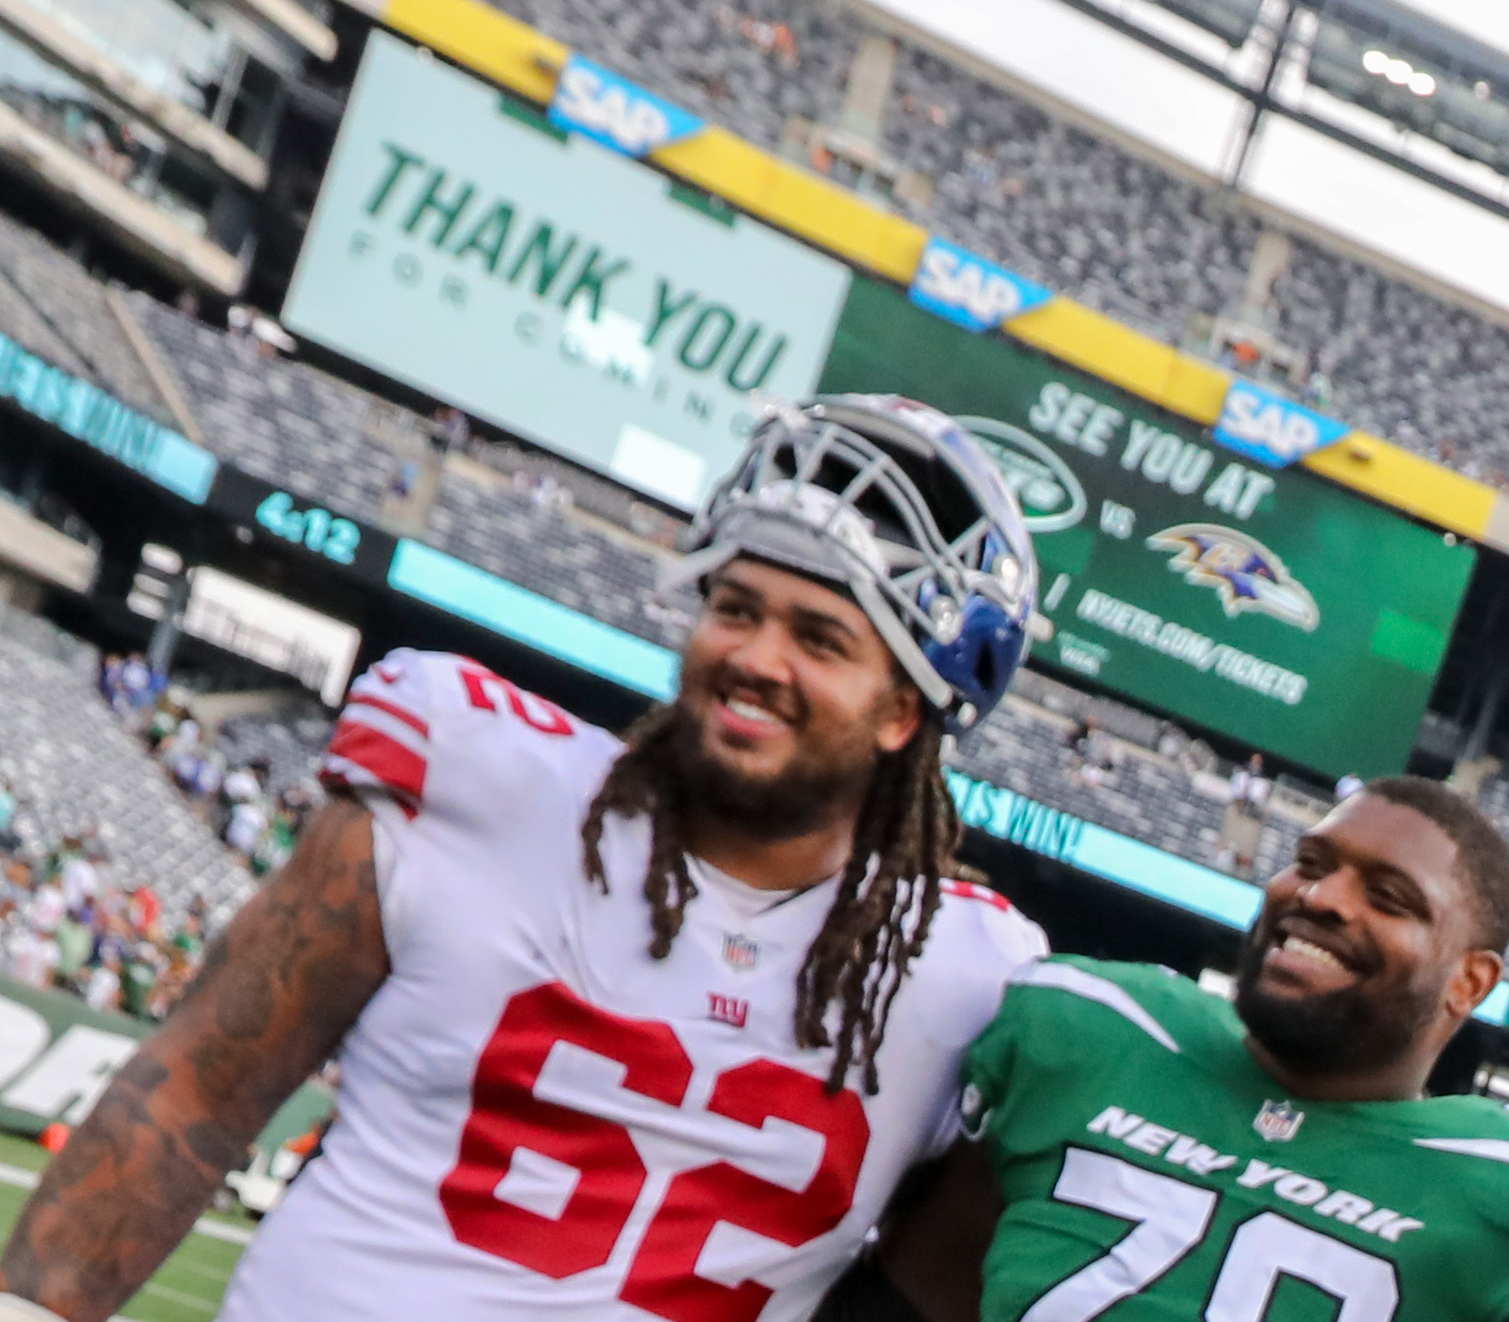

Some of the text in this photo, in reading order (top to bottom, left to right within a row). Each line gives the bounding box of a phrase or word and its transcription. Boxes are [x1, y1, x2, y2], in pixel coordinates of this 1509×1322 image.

[560, 64, 671, 148] SAP
[348, 227, 473, 310] FOR
[361, 136, 792, 394] THANK YOU
[918, 246, 1024, 326] SAP
[1028, 381, 1125, 458] SEE
[1119, 418, 1215, 496] YOU
[1201, 462, 1277, 520] AT
[1215, 388, 1321, 460] SAP
[256, 491, 362, 565] 4:12
[1076, 588, 1309, 705] NYJETS.COM/TICKETS
[1086, 1104, 1426, 1243] NEW YORK
